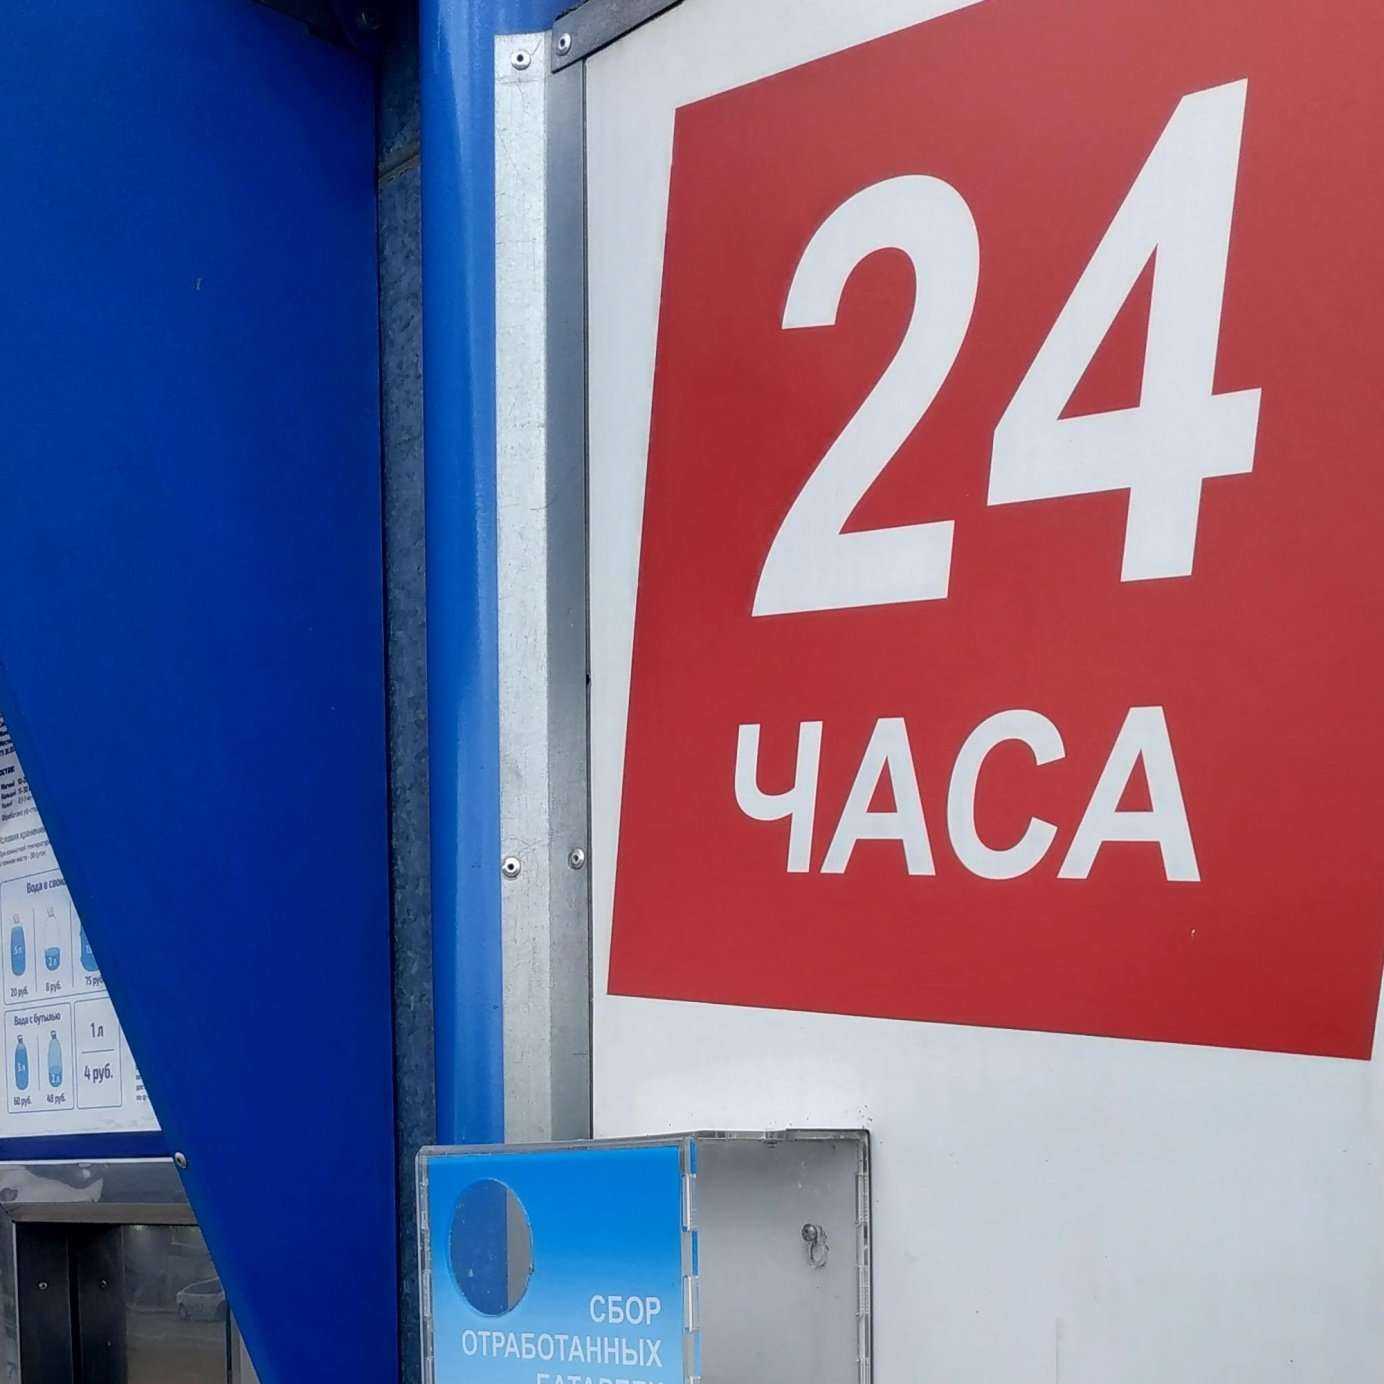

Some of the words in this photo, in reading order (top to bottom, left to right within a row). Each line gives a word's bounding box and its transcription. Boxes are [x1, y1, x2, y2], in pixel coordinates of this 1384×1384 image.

[753, 79, 1261, 617] 24
[734, 706, 1201, 882] ЧАСА
[91, 1023, 96, 1038] 1
[97, 1025, 104, 1037] л
[84, 1066, 91, 1080] 4
[92, 1063, 114, 1084] руб.
[590, 1294, 662, 1325] СБОР
[461, 1329, 663, 1368] ОТРАБОТАННЫХ
